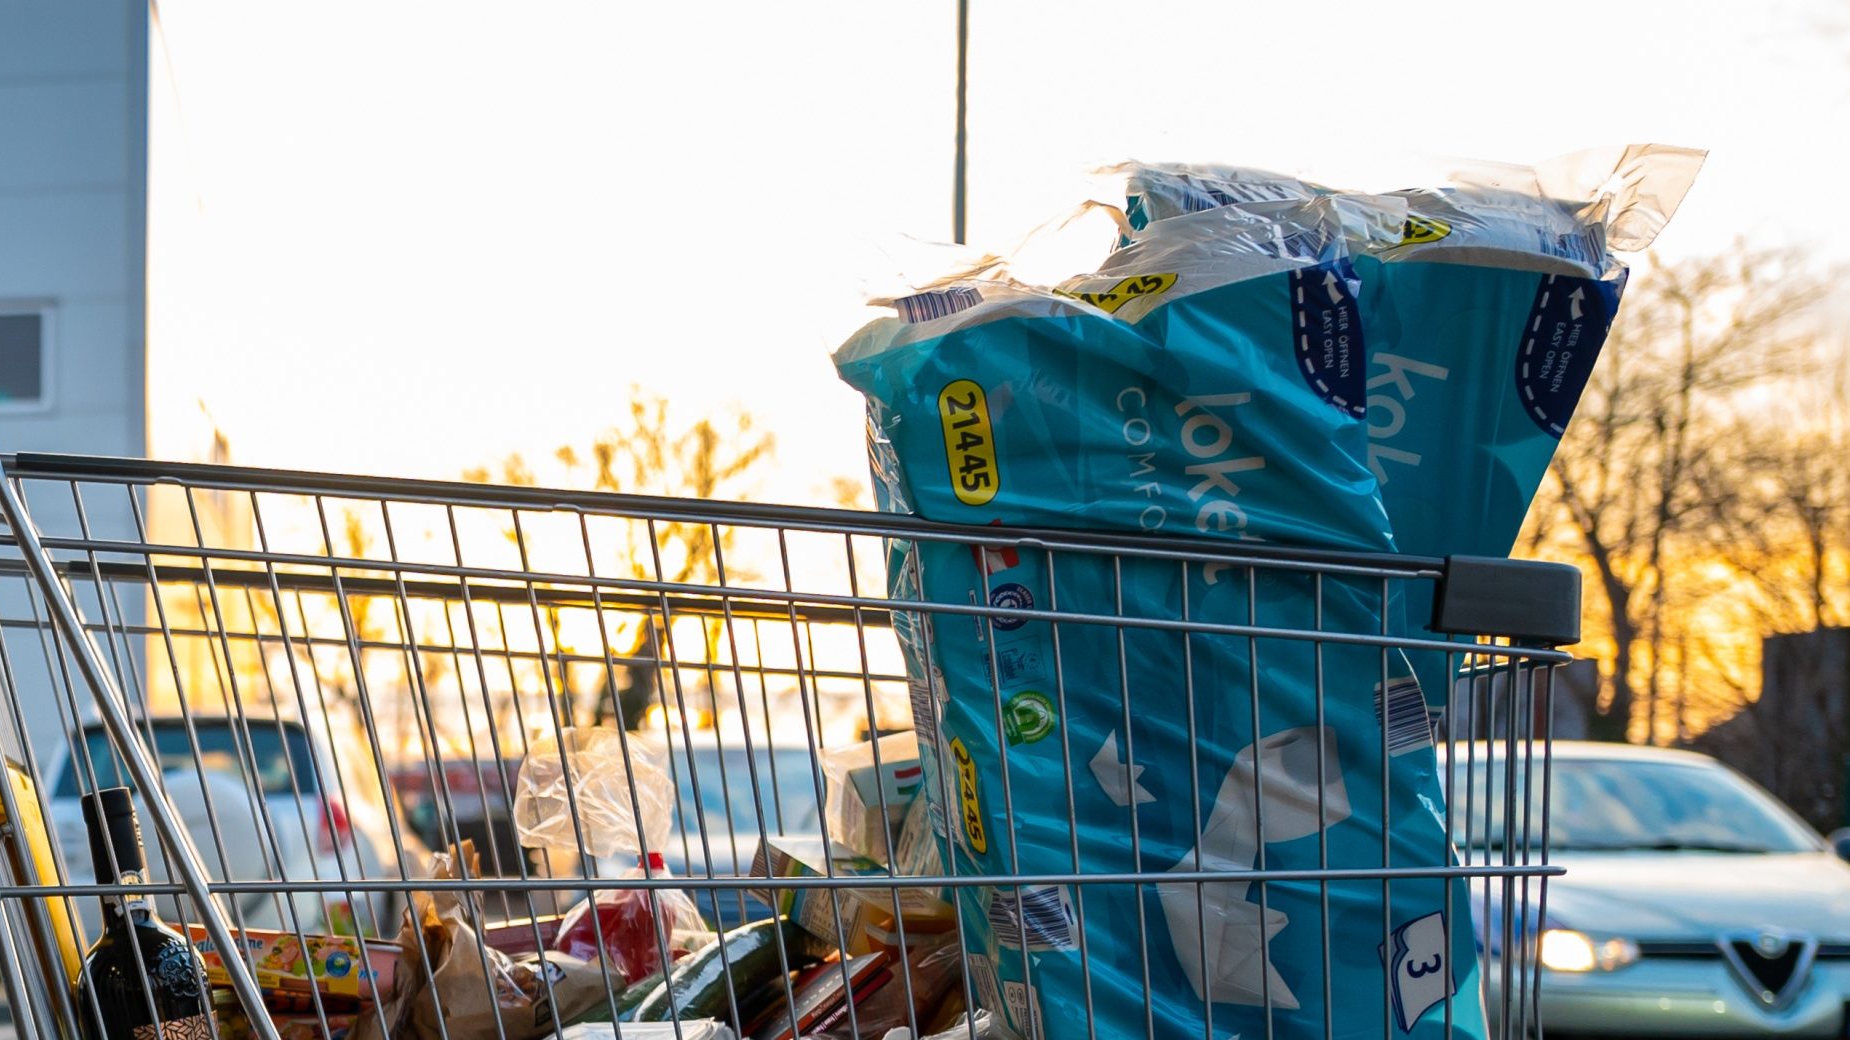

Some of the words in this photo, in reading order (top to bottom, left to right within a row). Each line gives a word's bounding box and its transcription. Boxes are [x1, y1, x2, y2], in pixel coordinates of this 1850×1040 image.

[1322, 309, 1333, 335] EASY
[1338, 306, 1349, 331] HIER
[1551, 321, 1566, 348] EASY
[1566, 323, 1582, 348] HIER
[1323, 339, 1334, 369] OPEN
[1338, 336, 1350, 378] ÖFFNEN
[1539, 350, 1556, 379] OPEN
[1550, 351, 1572, 393] ÖFFNEN
[946, 391, 991, 493] 21445
[1116, 386, 1167, 532] COMFO
[1406, 953, 1442, 978] 3
